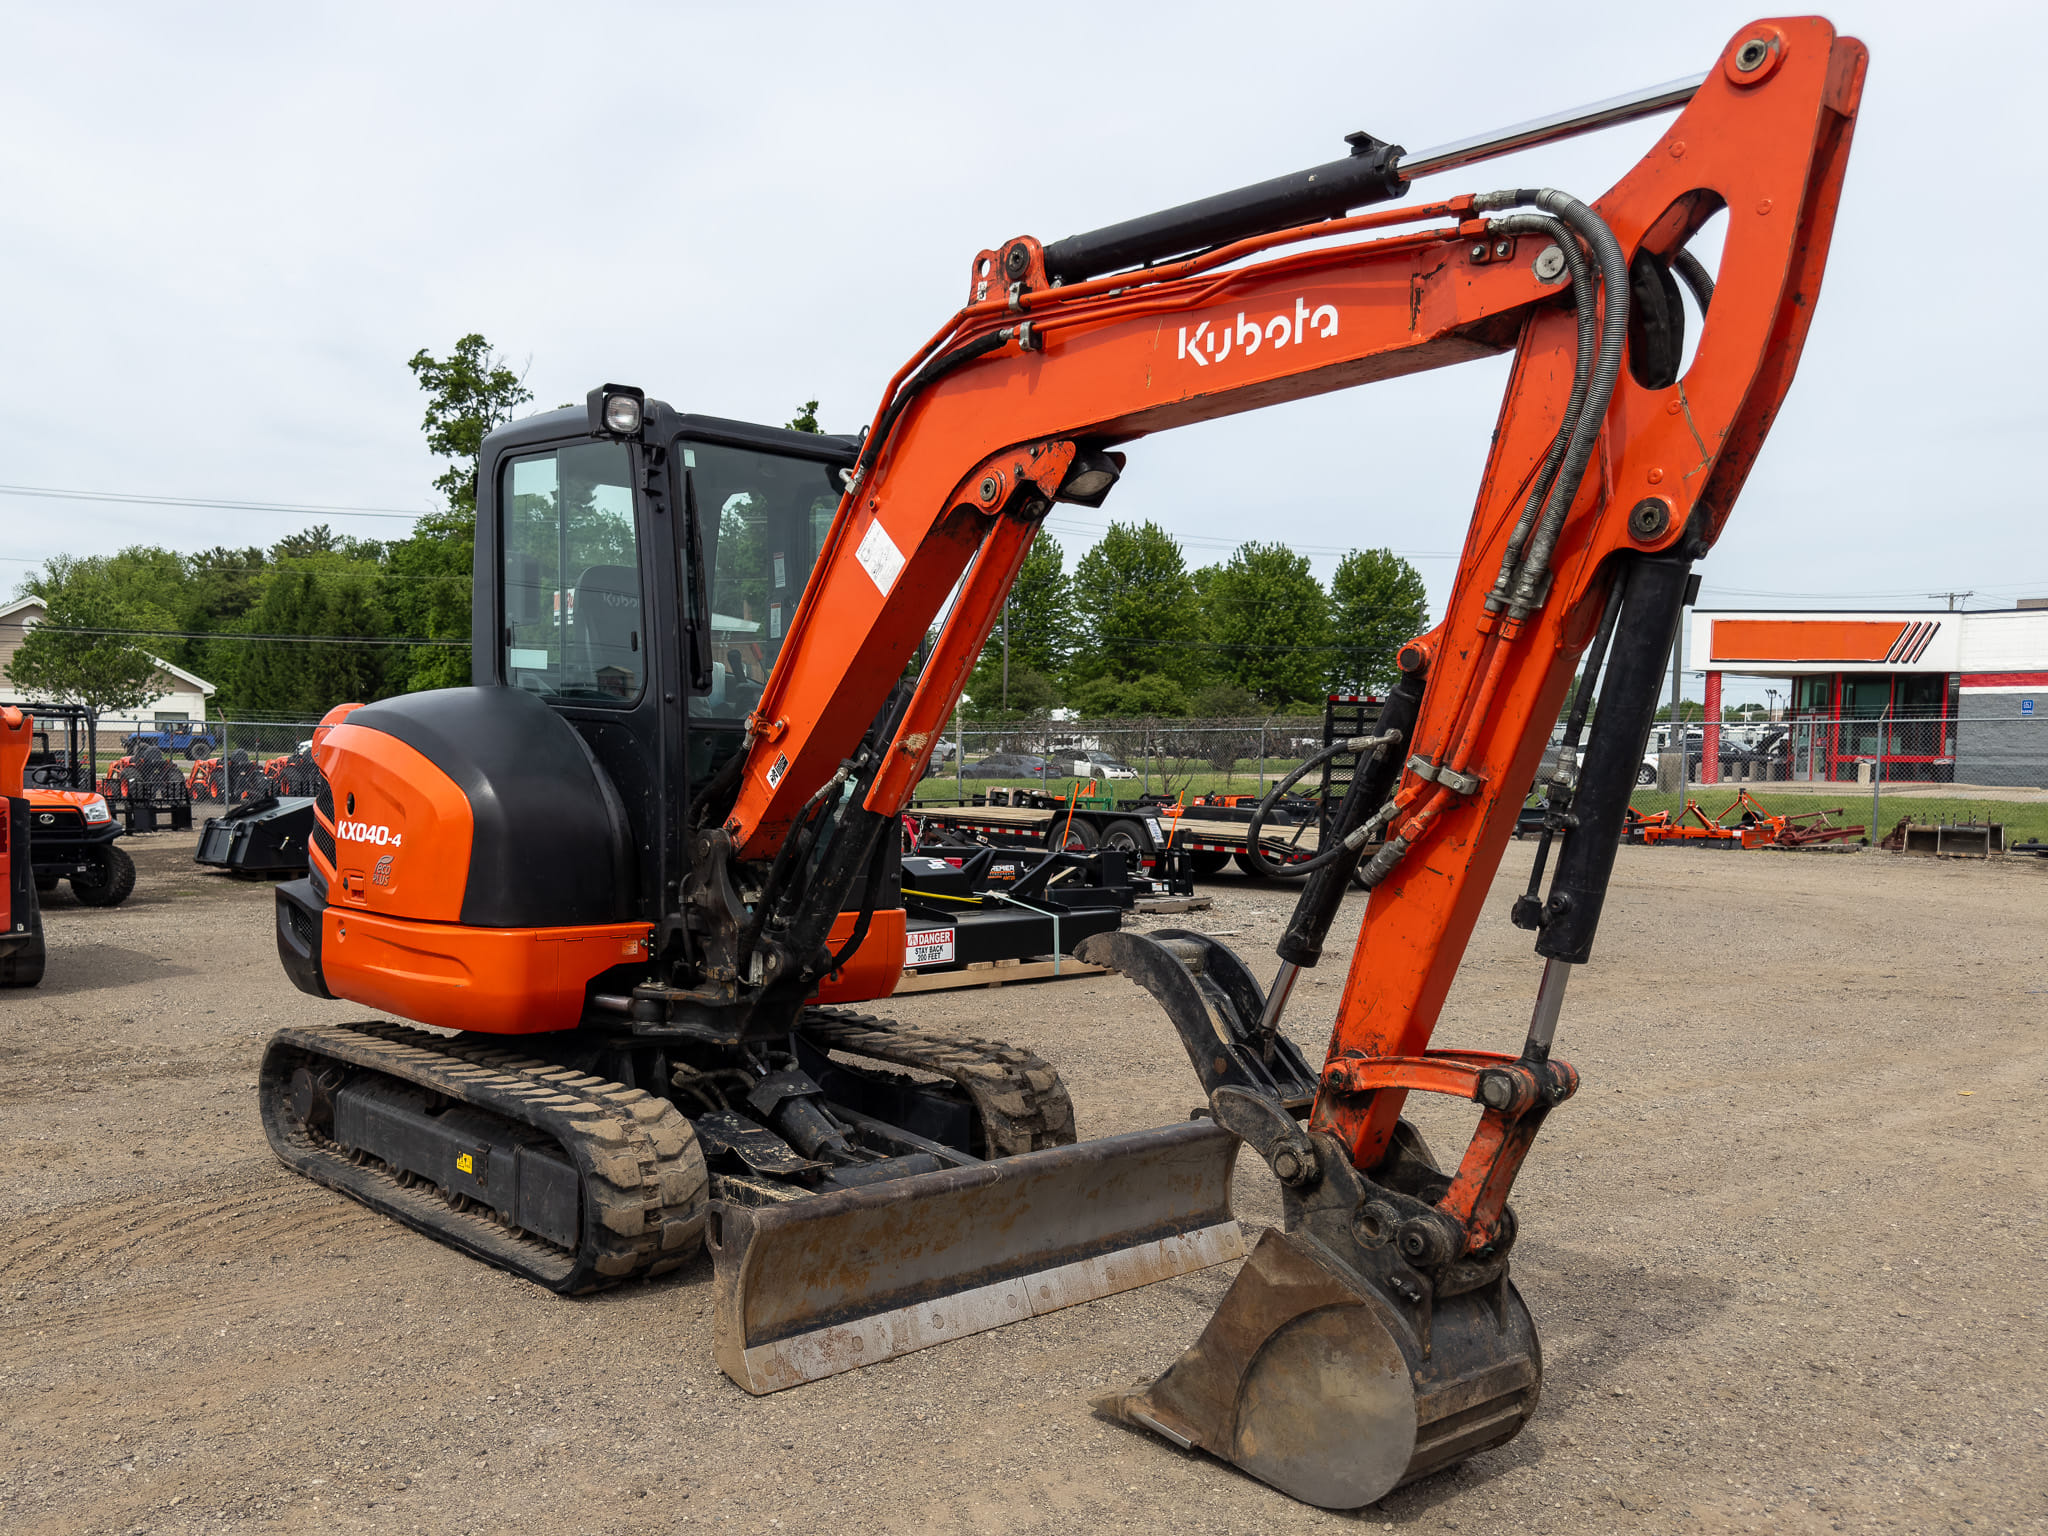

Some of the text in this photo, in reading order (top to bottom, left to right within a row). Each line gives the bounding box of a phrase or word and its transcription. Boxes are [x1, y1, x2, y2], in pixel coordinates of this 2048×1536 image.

[1177, 297, 1339, 367] Kubota
[336, 820, 402, 848] KX040-4
[372, 873, 391, 887] PLUS
[918, 931, 951, 945] DANGER
[915, 945, 944, 955] STAY BACK
[917, 952, 941, 962] 200 FEET
